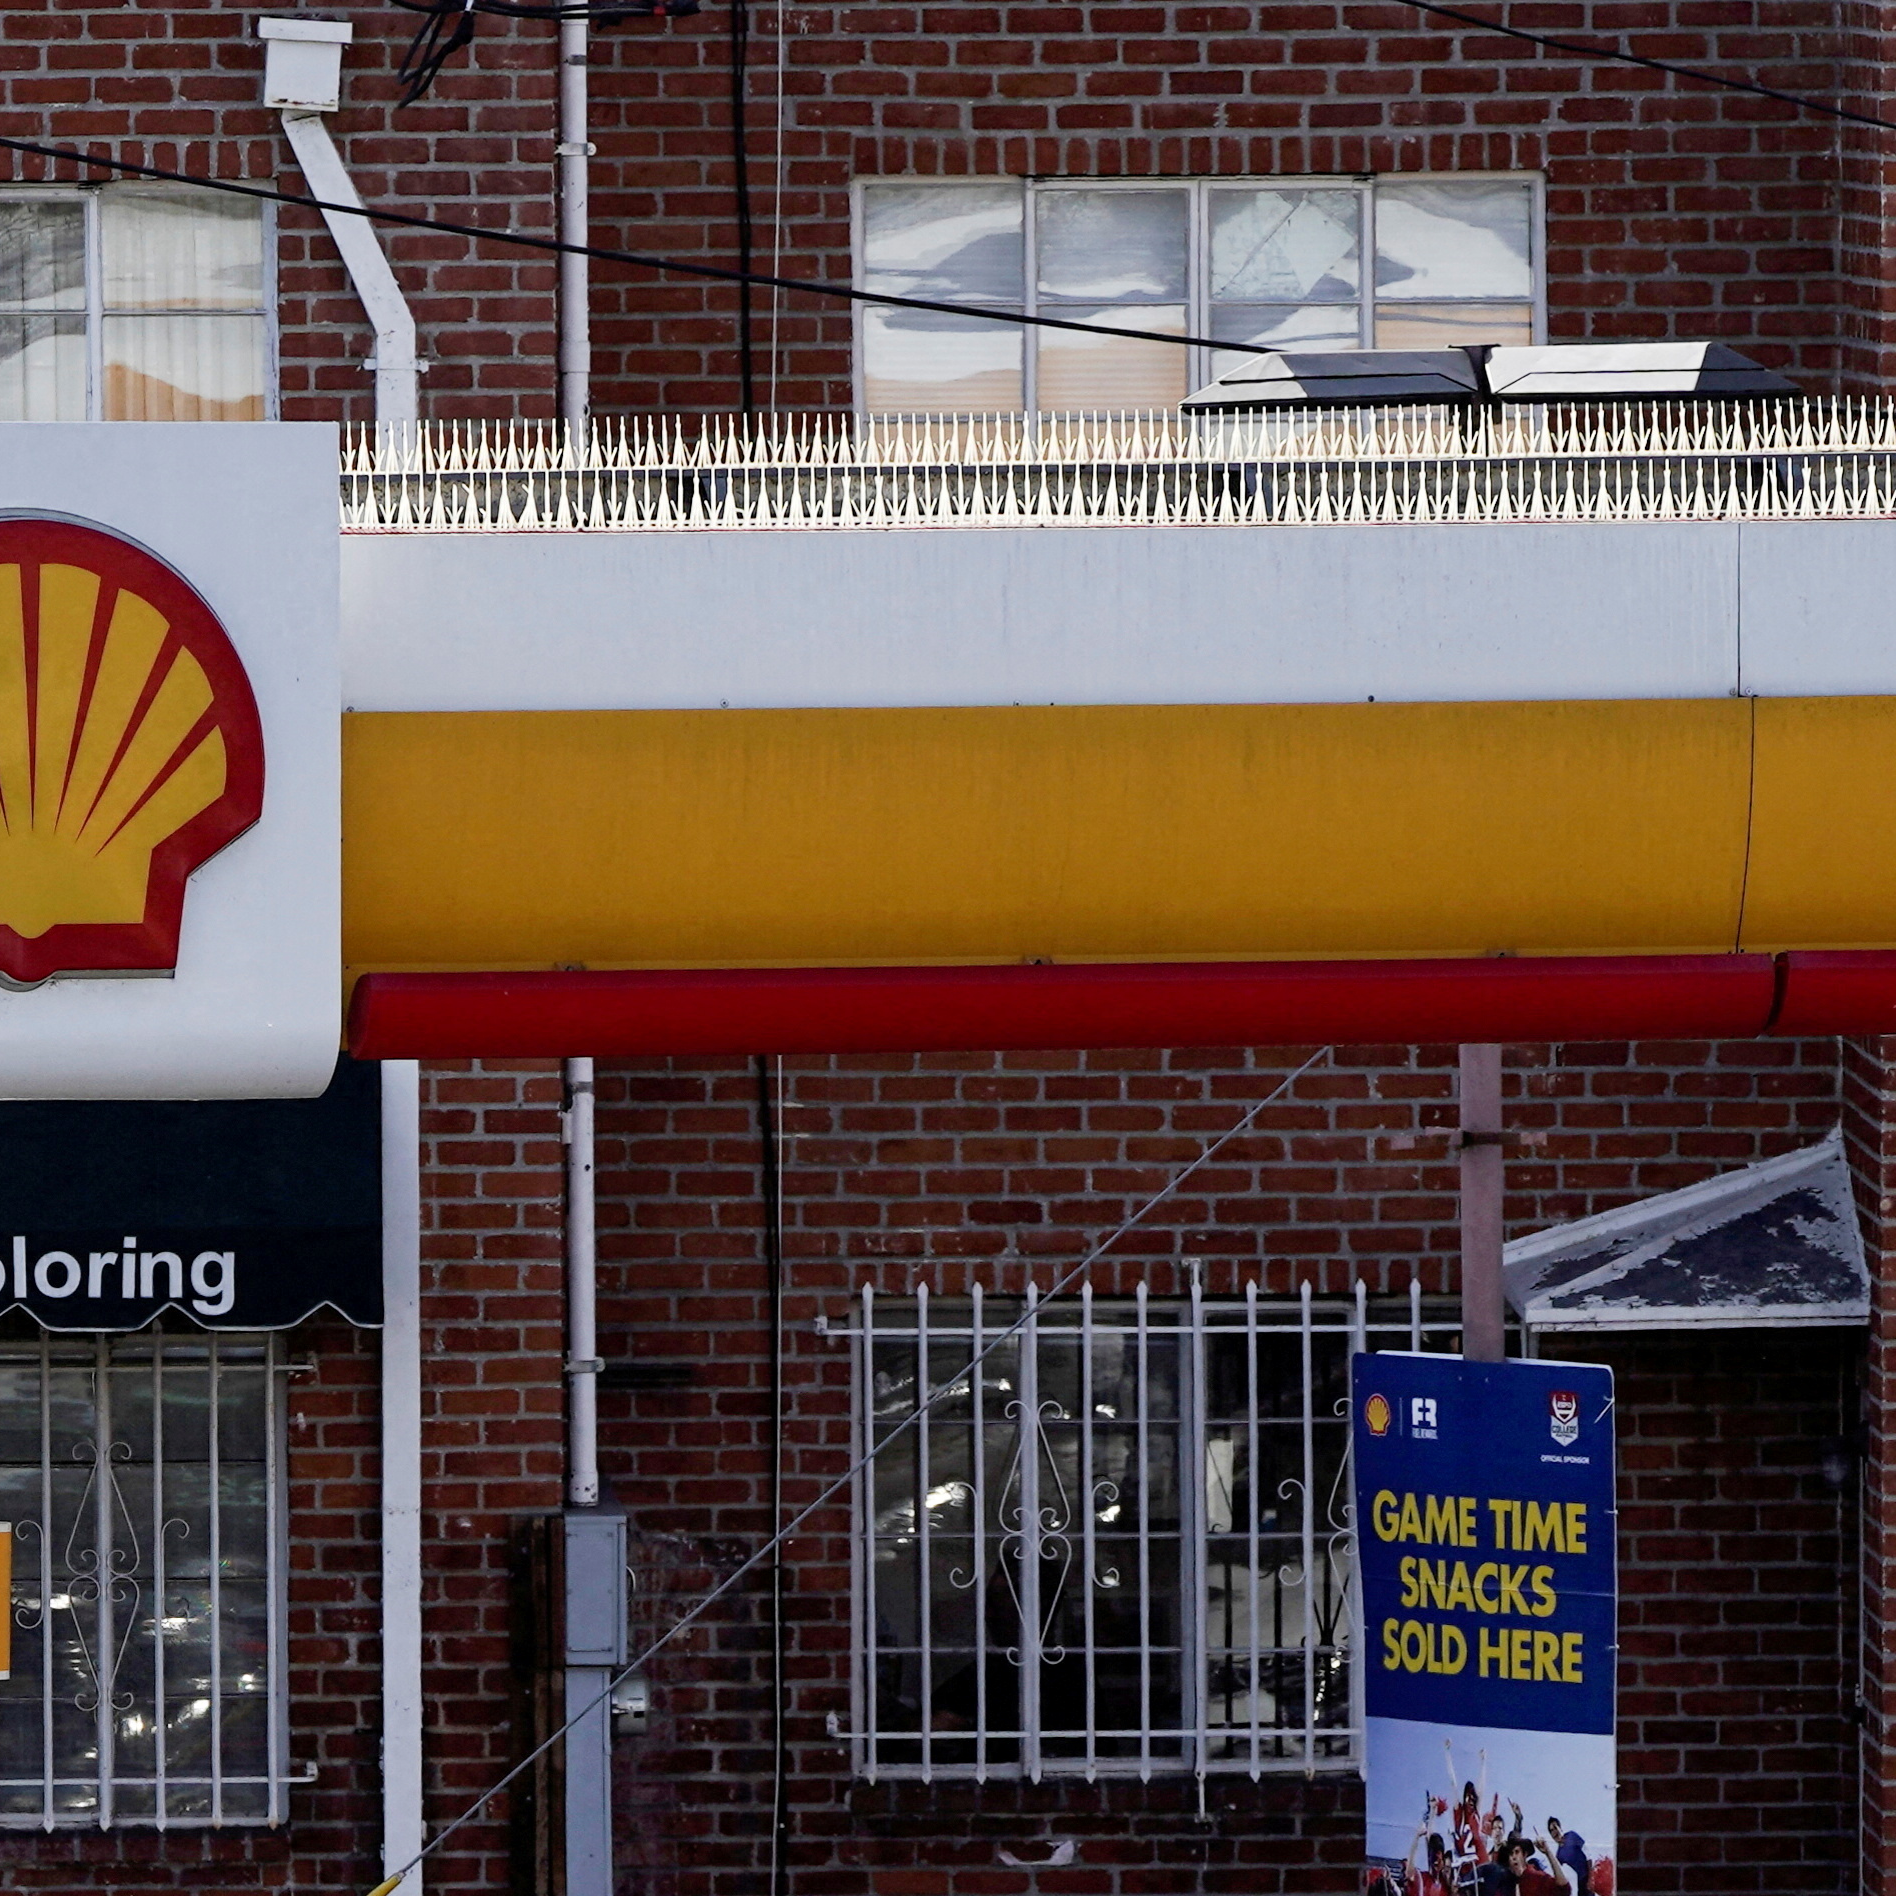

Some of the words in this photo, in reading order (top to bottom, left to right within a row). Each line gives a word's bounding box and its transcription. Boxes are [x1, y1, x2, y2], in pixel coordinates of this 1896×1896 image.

[1372, 1489, 1477, 1548] GAME
[1488, 1498, 1587, 1554] TIME
[1399, 1555, 1557, 1618] SNACKS
[1383, 1617, 1467, 1675] SOLD
[1479, 1626, 1583, 1684] HERE
